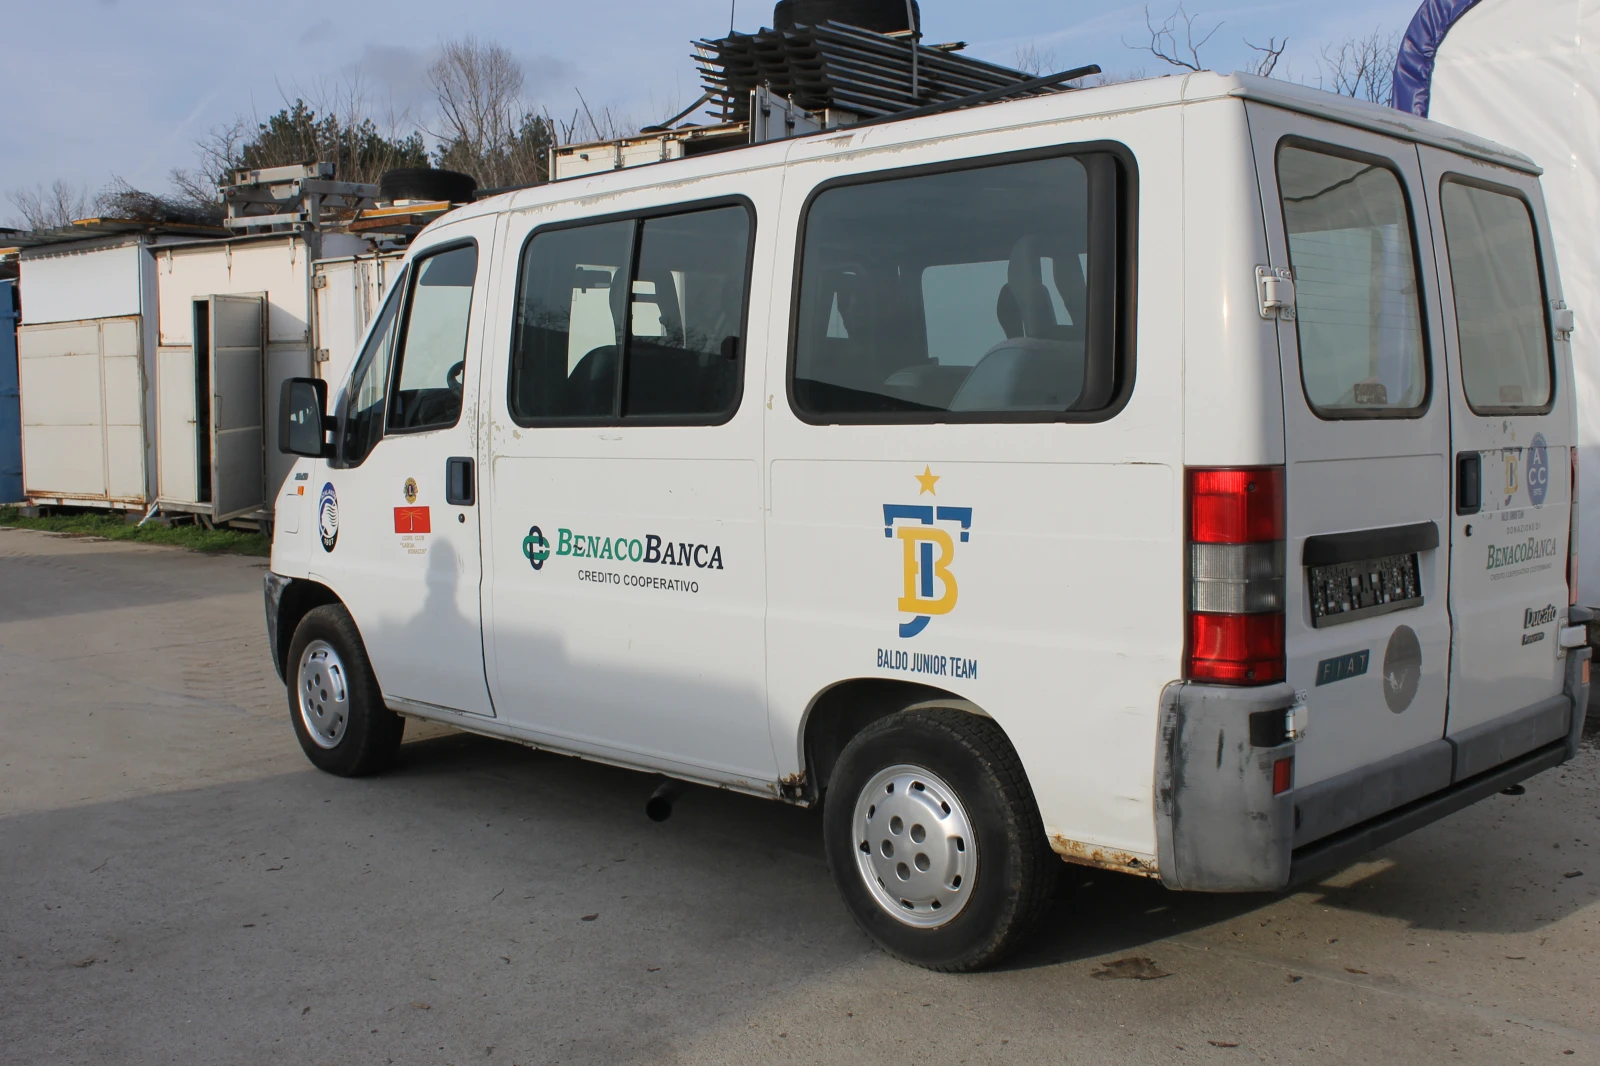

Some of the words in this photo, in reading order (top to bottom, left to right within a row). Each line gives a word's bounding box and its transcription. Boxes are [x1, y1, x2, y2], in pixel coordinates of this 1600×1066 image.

[577, 569, 621, 585] CREDITO
[623, 574, 699, 593] COOPERATIVO
[1523, 603, 1557, 630] Ducato
[877, 648, 908, 671] BALDO
[911, 652, 947, 676] JUNIOR
[950, 656, 978, 680] TEAM
[1321, 652, 1368, 682] FIAT
